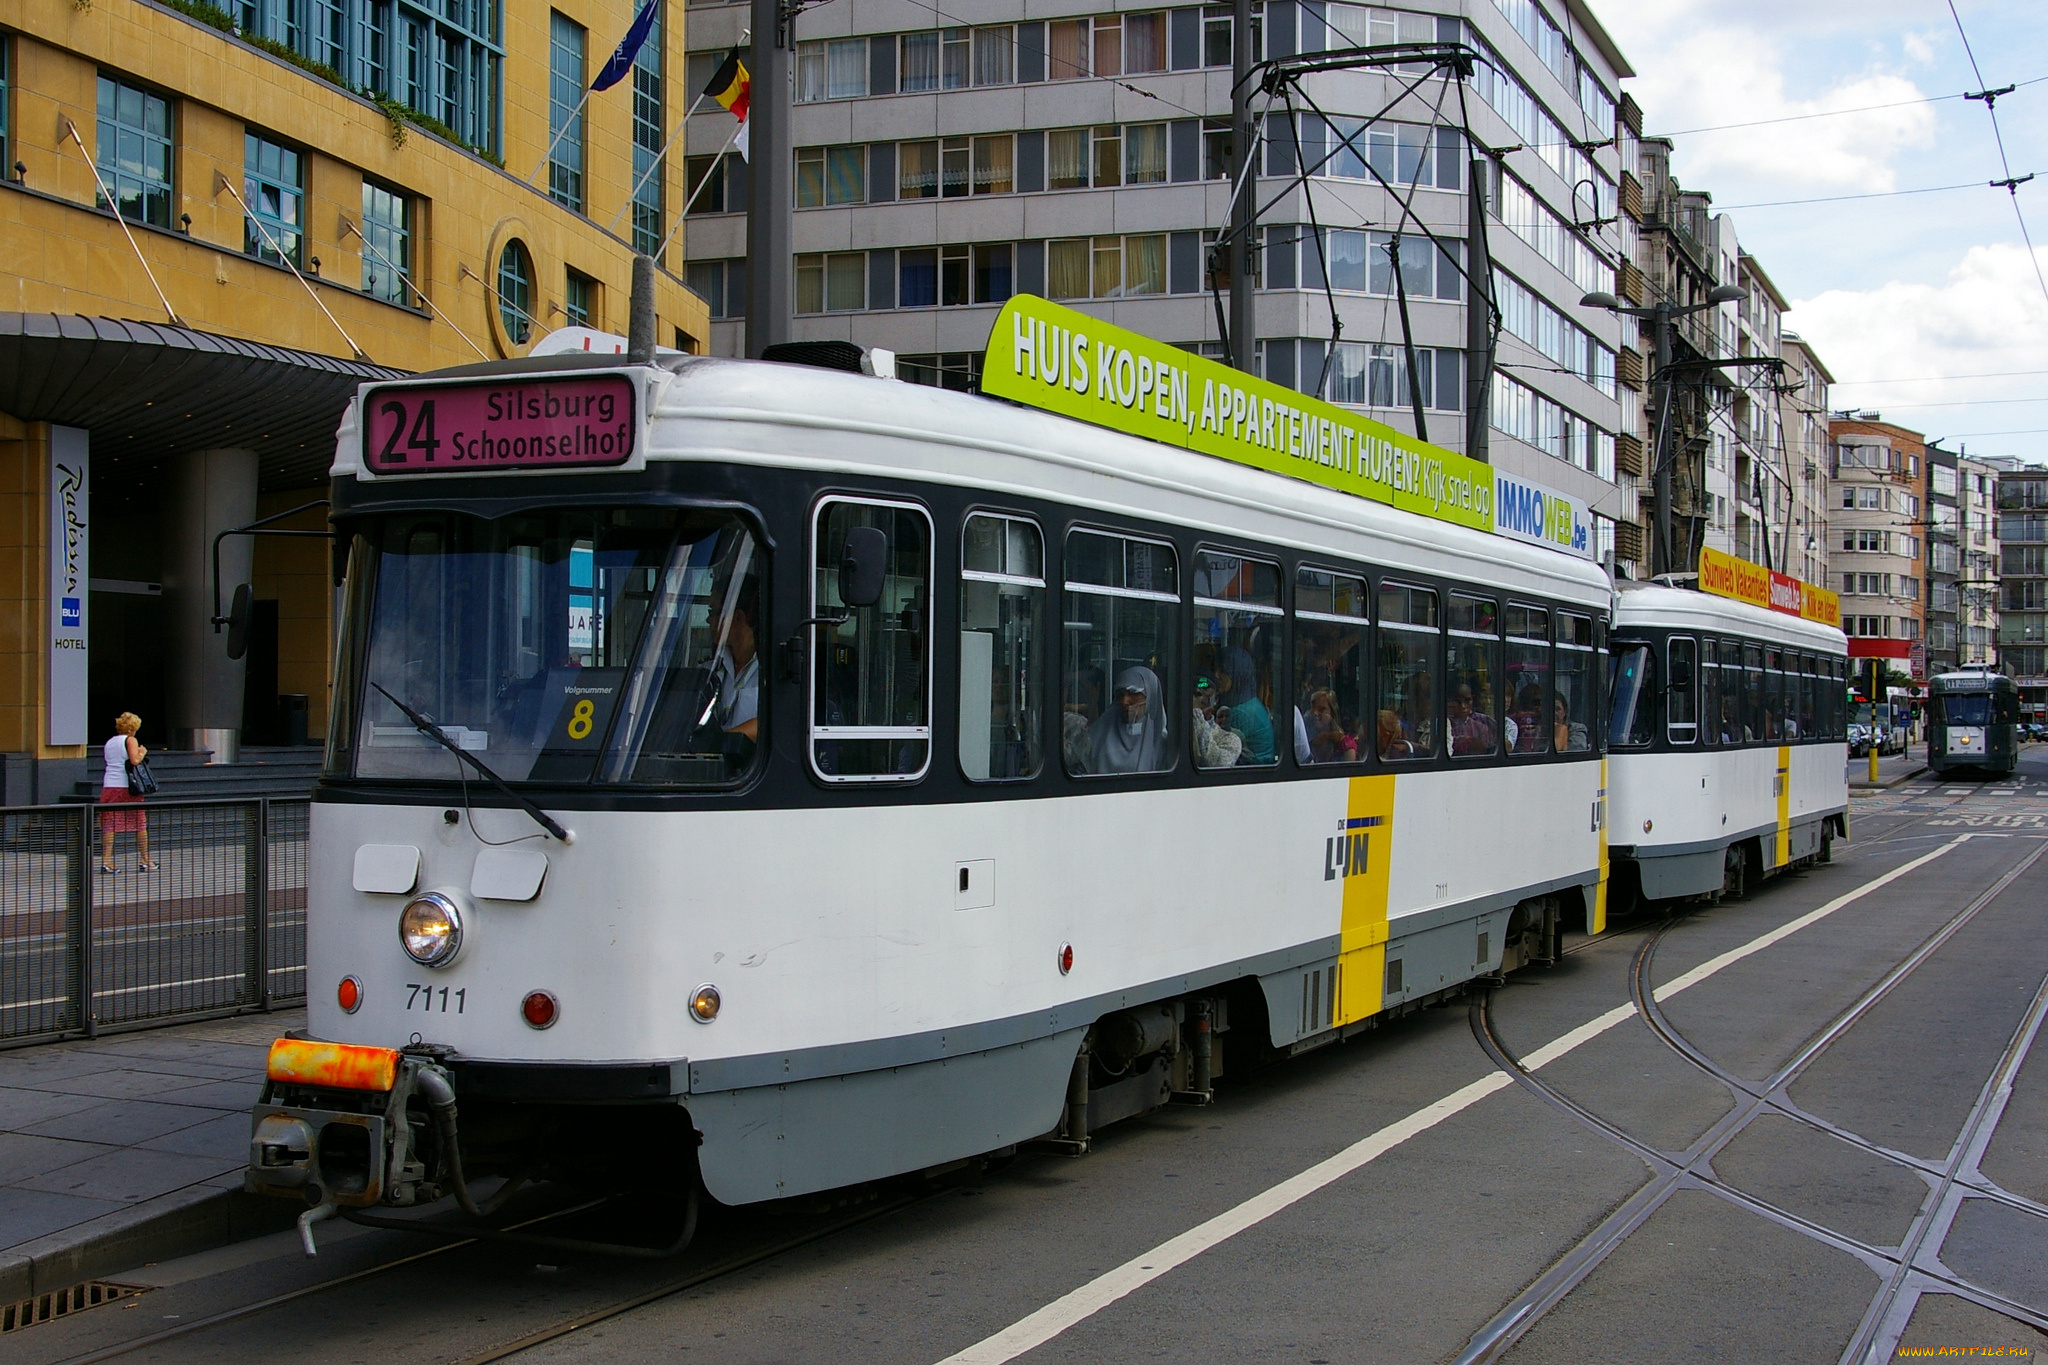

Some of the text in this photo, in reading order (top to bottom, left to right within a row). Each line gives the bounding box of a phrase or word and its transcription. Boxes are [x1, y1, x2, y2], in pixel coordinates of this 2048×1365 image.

[487, 389, 615, 424] Silsburg
[379, 399, 441, 464] 24
[451, 424, 627, 462] Schoonselhof
[1013, 311, 1587, 552] HUIS KOPEN, APPARTEMENT HUREN? Kijk snel op IMMOWEB.be
[55, 462, 88, 594] Radisson
[1703, 551, 1734, 594] Sunweb
[1735, 562, 1768, 604] Vakanties
[62, 608, 80, 619] BLU
[55, 638, 87, 650] HOTEL
[564, 685, 614, 695] Volgnummer
[567, 699, 595, 740] 8
[1336, 818, 1346, 832] DE
[1324, 833, 1369, 881] LIJN
[1435, 883, 1448, 899] 7111
[406, 984, 466, 1014] 7111
